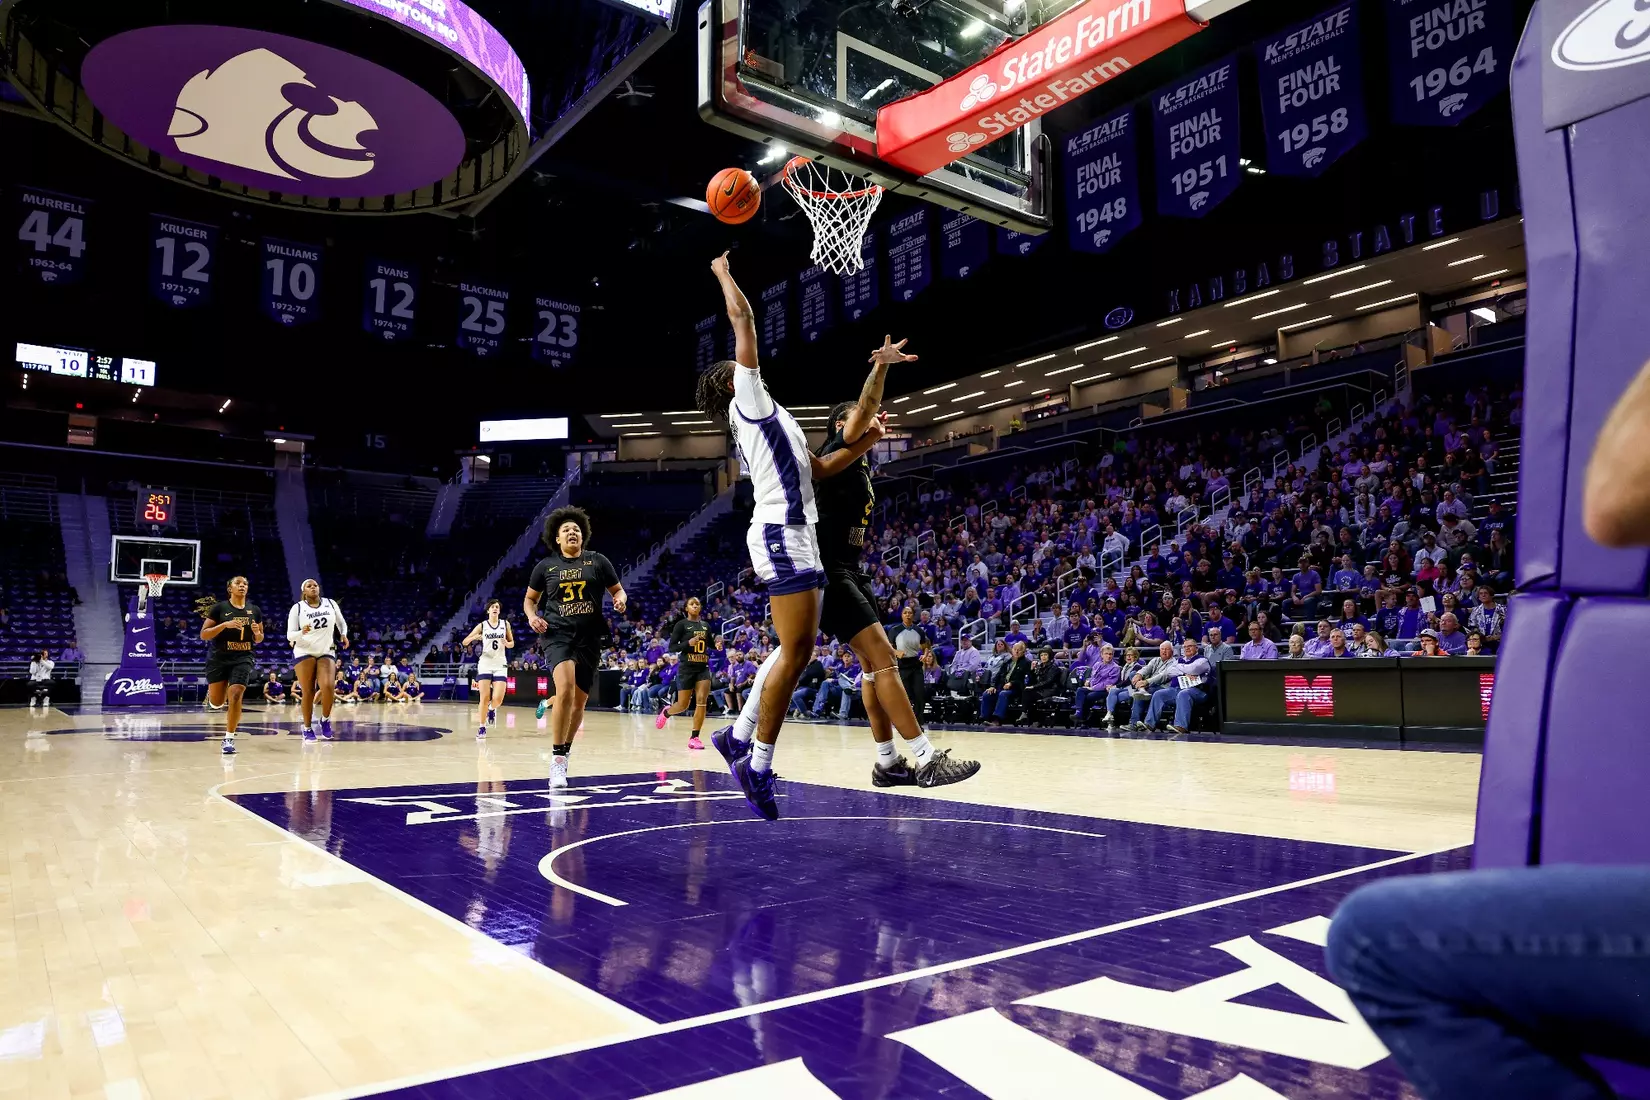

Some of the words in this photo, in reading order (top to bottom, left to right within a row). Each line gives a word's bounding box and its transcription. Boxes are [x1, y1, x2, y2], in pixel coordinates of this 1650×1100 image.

[1409, 0, 1487, 38] FINAL
[437, 21, 458, 42] MO
[1264, 8, 1350, 61] K-STATE
[1411, 10, 1486, 58] FOUR
[1270, 50, 1294, 66] MEN'S
[1295, 27, 1345, 55] BASKETBALL
[1278, 55, 1341, 96] FINAL
[1409, 46, 1497, 102] 1964
[1158, 64, 1230, 111] K-STATE
[1163, 102, 1183, 115] MEN'S
[1184, 82, 1226, 106] BASKETBALL
[1279, 73, 1341, 114] FOUR
[1067, 113, 1130, 152] K-STATE
[1169, 107, 1222, 143] FINAL
[1277, 107, 1349, 153] 1958
[1071, 146, 1089, 157] MEN'S
[1089, 129, 1125, 149] BASKETBALL
[1170, 124, 1222, 160] FOUR
[1076, 152, 1122, 183] FINAL
[1171, 155, 1227, 195] 1951
[1077, 168, 1122, 200] FOUR
[22, 193, 86, 215] MURRELL
[1076, 197, 1127, 233] 1948
[160, 222, 208, 240] KRUGER
[890, 209, 925, 234] K-STATE
[942, 217, 960, 231] SWEET
[18, 208, 86, 258] 44
[948, 238, 961, 249] 2023
[266, 243, 318, 261] WILLIAMS
[888, 243, 905, 257] SWEET
[906, 233, 927, 249] SIXTEEN
[29, 257, 73, 272] 1962-64
[155, 237, 210, 283] 12
[1167, 252, 1295, 313] KANSAS
[1322, 204, 1445, 268] STATE
[266, 258, 315, 301] 10
[377, 265, 409, 279] EVANS
[160, 282, 201, 295] 1971-74
[369, 278, 415, 319] 12
[460, 283, 509, 299] BLACKMAN
[761, 279, 788, 300] K-STATE
[806, 281, 820, 295] NCAA
[271, 301, 307, 314] 1972-76
[461, 296, 505, 335] 25
[535, 298, 581, 313] RICHMOND
[768, 300, 781, 312] NCAA
[373, 318, 407, 331] 1974-78
[537, 311, 578, 348] 23
[468, 336, 498, 347] 1977-81
[22, 362, 37, 370] 1:17
[60, 358, 79, 371] 10
[96, 356, 113, 364] 2:57
[129, 368, 145, 380] 11
[365, 433, 386, 449] 15
[149, 494, 171, 505] 2:57
[144, 504, 166, 521] 26
[559, 580, 586, 602] 37
[313, 617, 328, 629] 22
[492, 640, 498, 651] 6
[113, 678, 163, 695] Dillons
